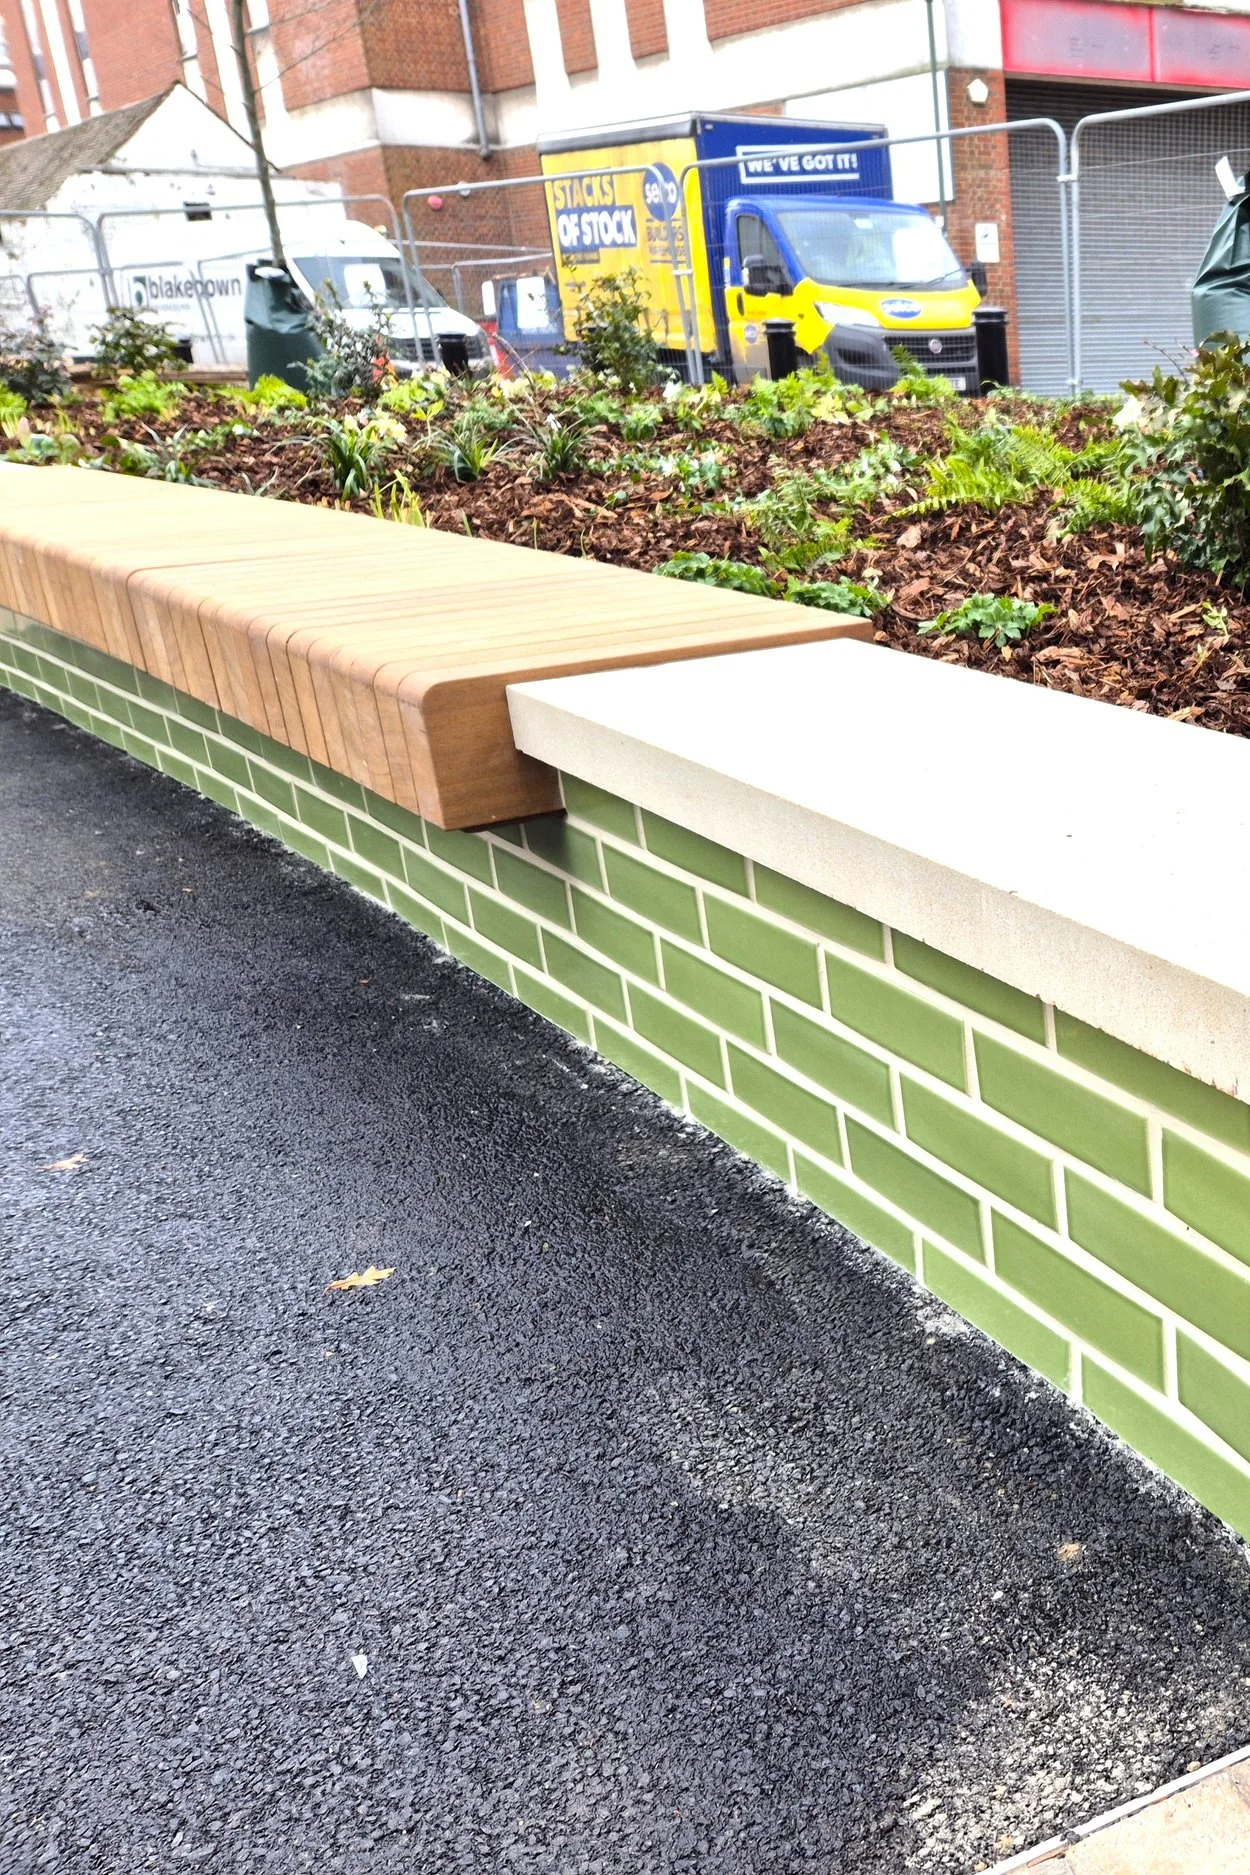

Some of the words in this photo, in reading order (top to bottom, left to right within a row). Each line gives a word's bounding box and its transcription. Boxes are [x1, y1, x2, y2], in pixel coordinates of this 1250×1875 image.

[747, 156, 800, 172] WE'VE
[802, 154, 834, 171] GOT
[836, 153, 858, 170] IT!
[553, 175, 613, 209] STACKS
[558, 213, 580, 247] OF
[580, 209, 636, 246] STOCK
